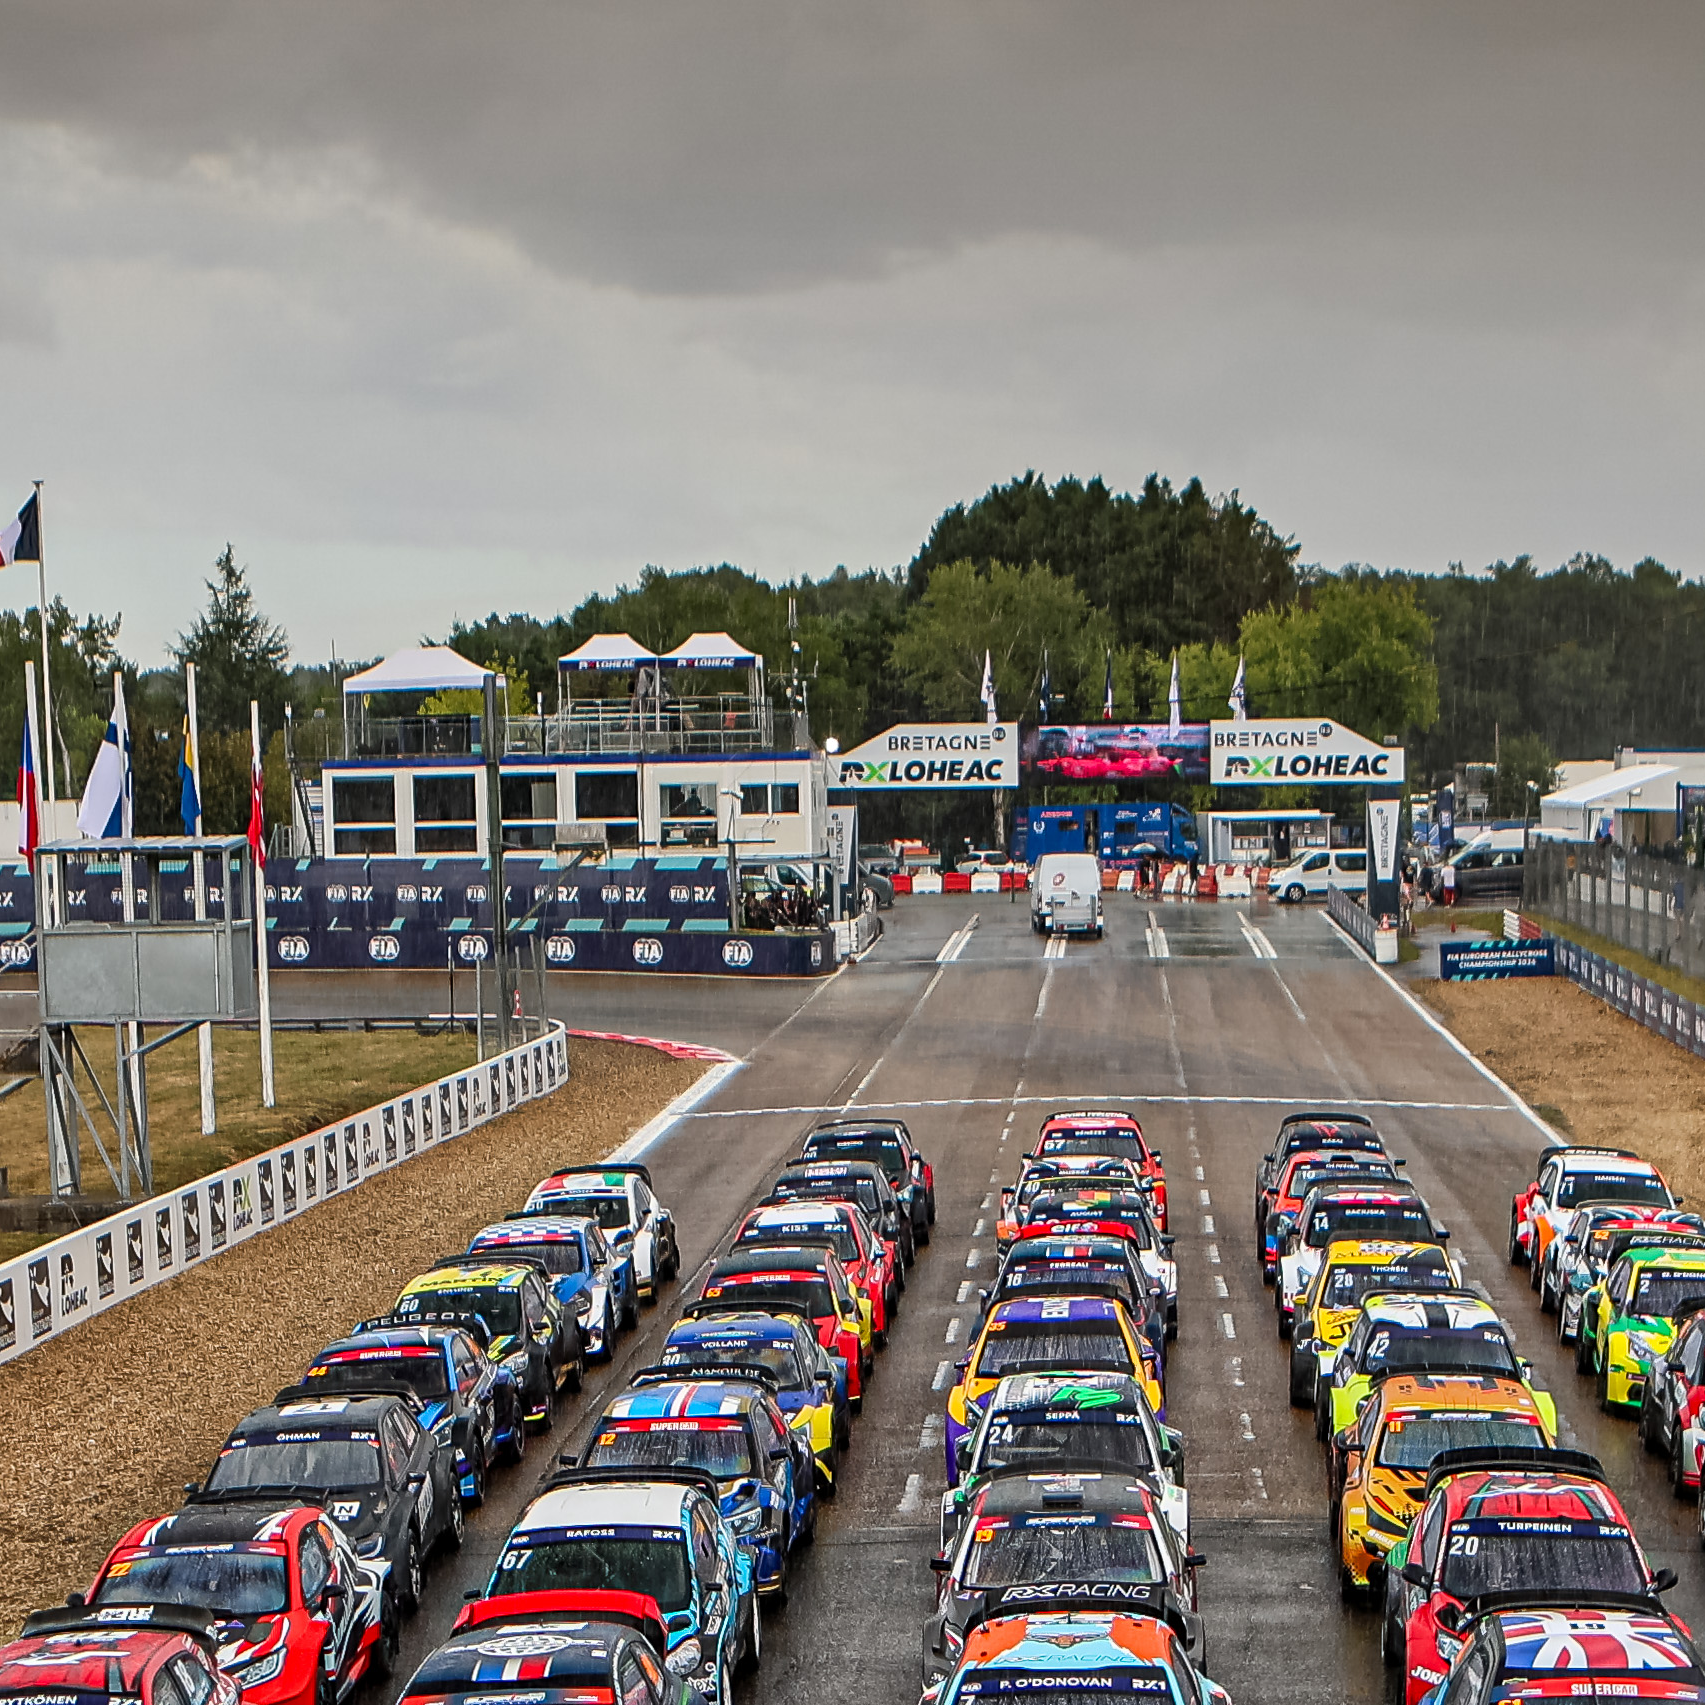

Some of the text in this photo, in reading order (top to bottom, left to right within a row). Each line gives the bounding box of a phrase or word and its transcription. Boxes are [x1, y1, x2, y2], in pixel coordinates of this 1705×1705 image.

[887, 735, 991, 752] BRETAGNE
[1213, 730, 1318, 748] BRETAGNE
[889, 760, 1004, 782] LOHEAC
[1274, 754, 1389, 776] LOHEAC
[278, 938, 309, 960] FIA
[369, 938, 399, 960] FIA
[546, 938, 575, 960] FIA
[633, 942, 662, 963] FIA
[723, 943, 752, 963] FIA
[1447, 949, 1548, 961] FIA EUROPEAN RALLYCROSS
[1459, 959, 1517, 969] CHAMPIONSHIP
[1024, 1181, 1040, 1192] 40
[1313, 1217, 1329, 1231] 14
[1006, 1274, 1022, 1287] 16
[1640, 1280, 1649, 1294] 2
[60, 1286, 89, 1316] LOHEAC
[399, 1298, 419, 1313] 60
[367, 1312, 470, 1327] PEUGEOT
[701, 1339, 748, 1349] VOLLAND
[1367, 1339, 1390, 1358] 42
[308, 1366, 328, 1377] 44
[988, 1424, 1013, 1444] 24
[1388, 1420, 1404, 1433] 11
[277, 1431, 321, 1442] ÖHMAN
[598, 1433, 617, 1445] 12
[1498, 1522, 1573, 1532] TURPEINEN
[975, 1529, 994, 1542] 19
[1449, 1536, 1478, 1556] 20
[501, 1550, 533, 1569] 67
[107, 1563, 133, 1578] 22
[1058, 1583, 1151, 1598] RACING
[999, 1678, 1112, 1689] P. O'DONOVAN
[1132, 1679, 1165, 1691] RX1
